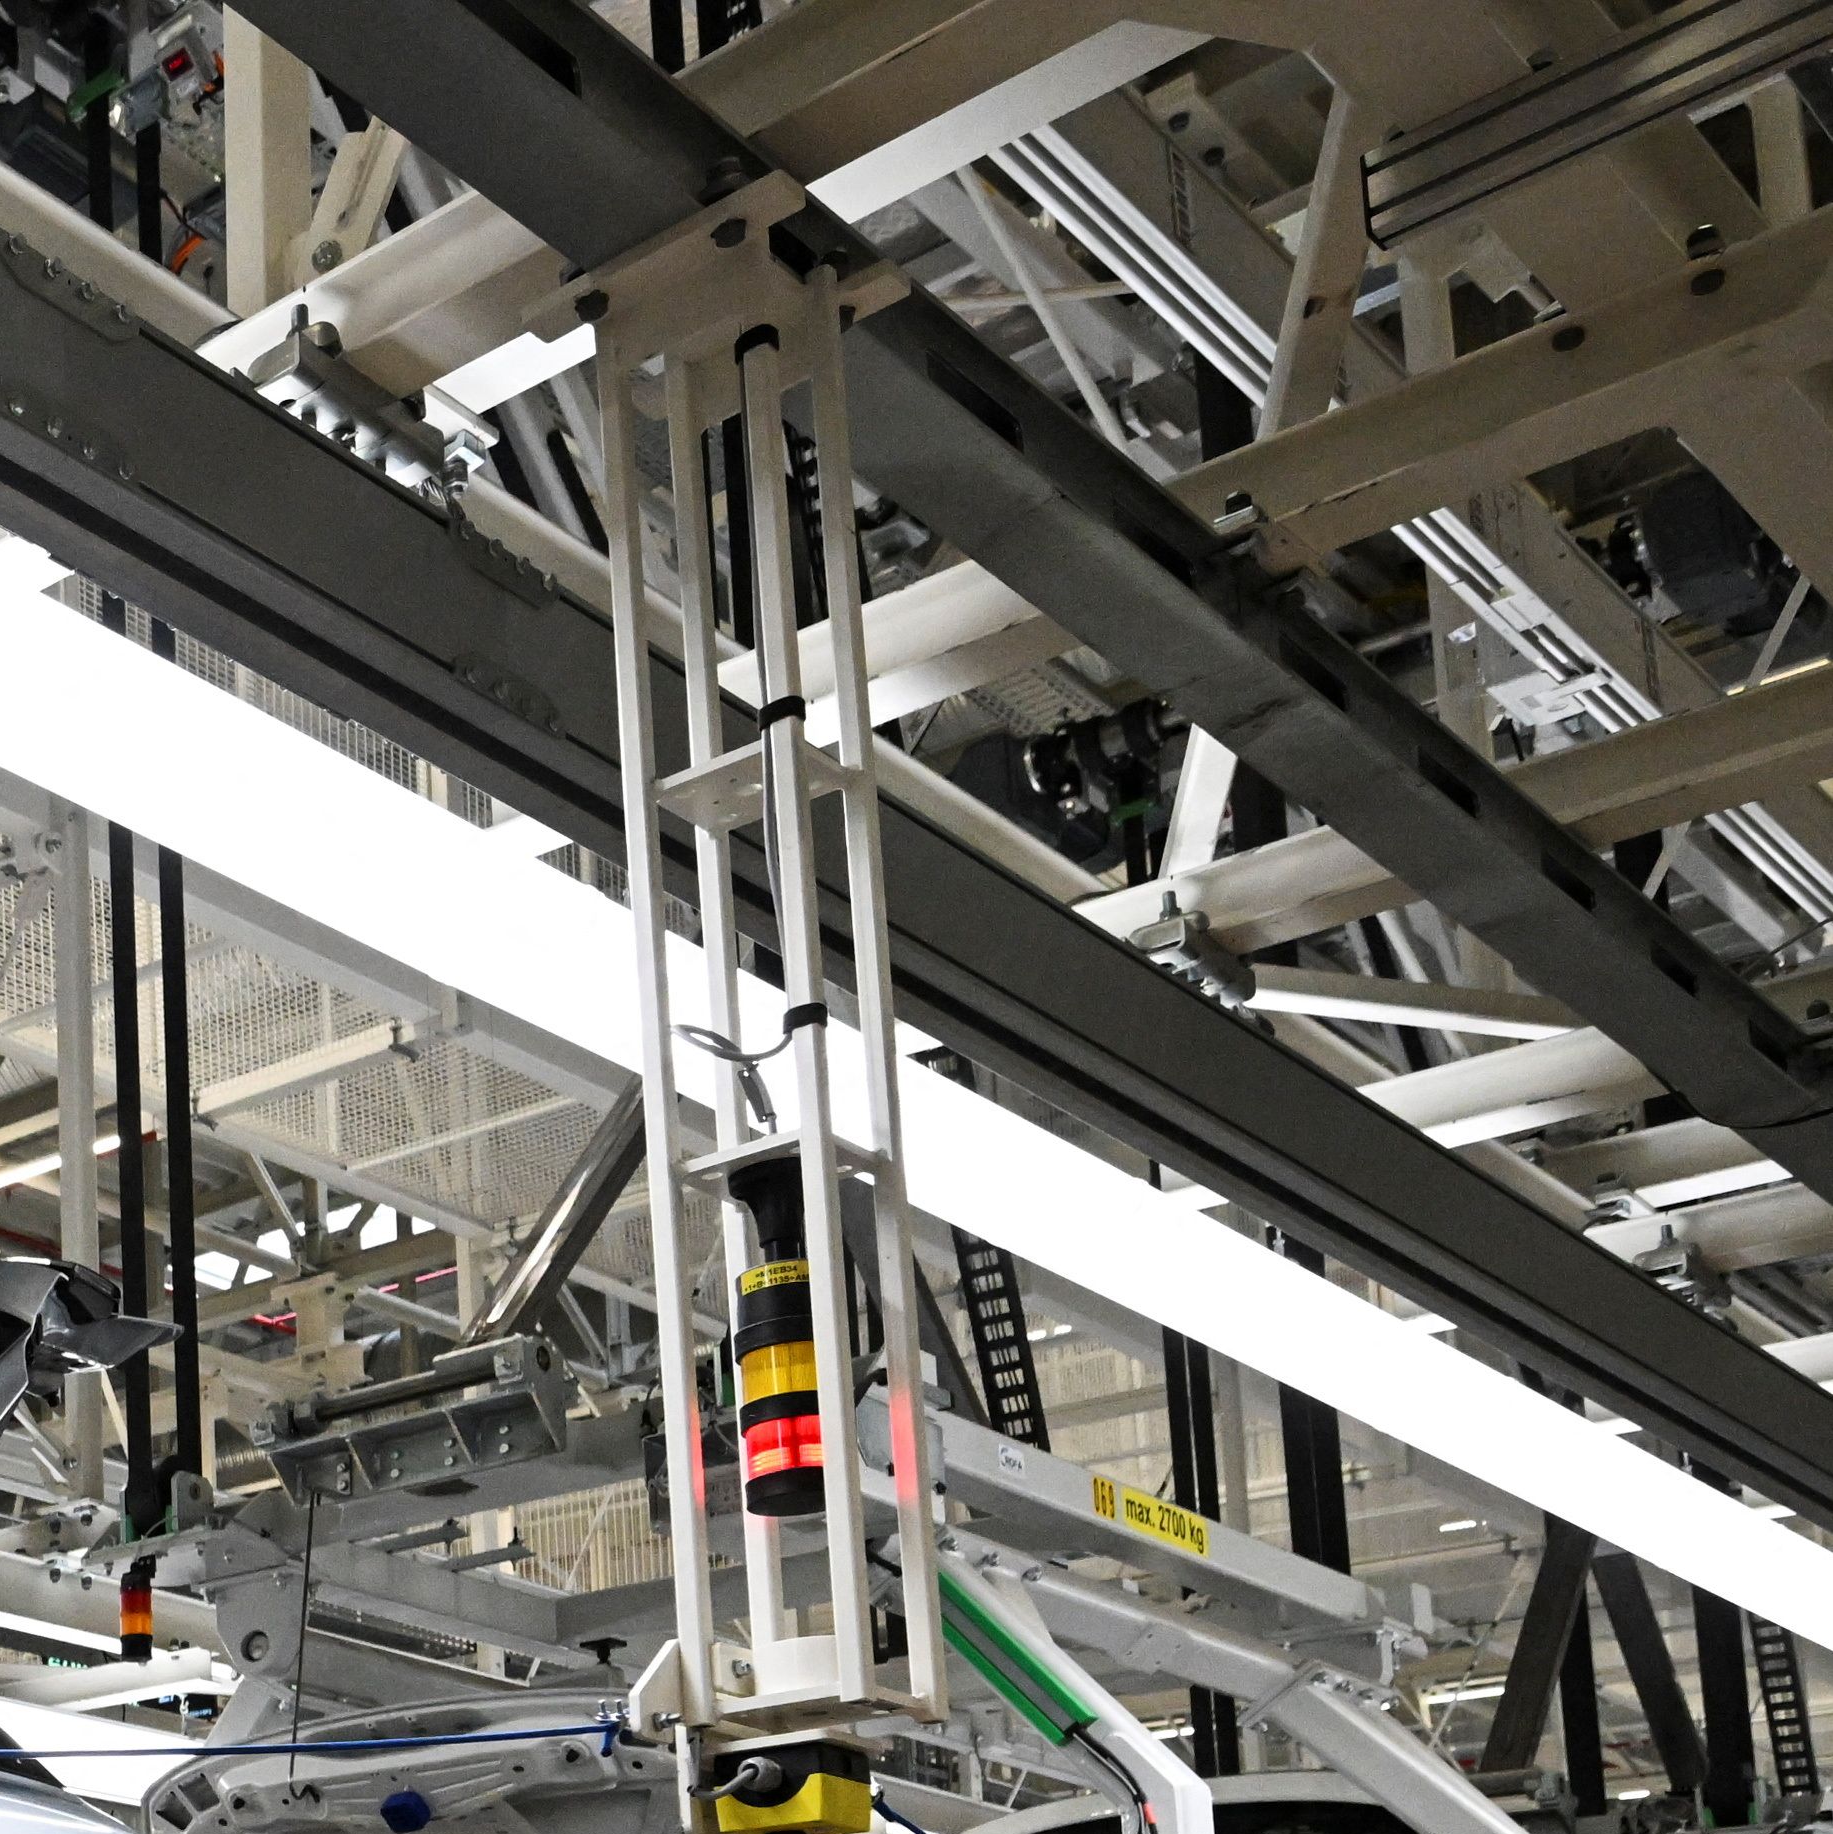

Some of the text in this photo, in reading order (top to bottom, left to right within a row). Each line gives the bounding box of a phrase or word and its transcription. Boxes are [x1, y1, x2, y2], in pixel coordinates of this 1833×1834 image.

[1126, 1498, 1204, 1554] max. 2700 kg
